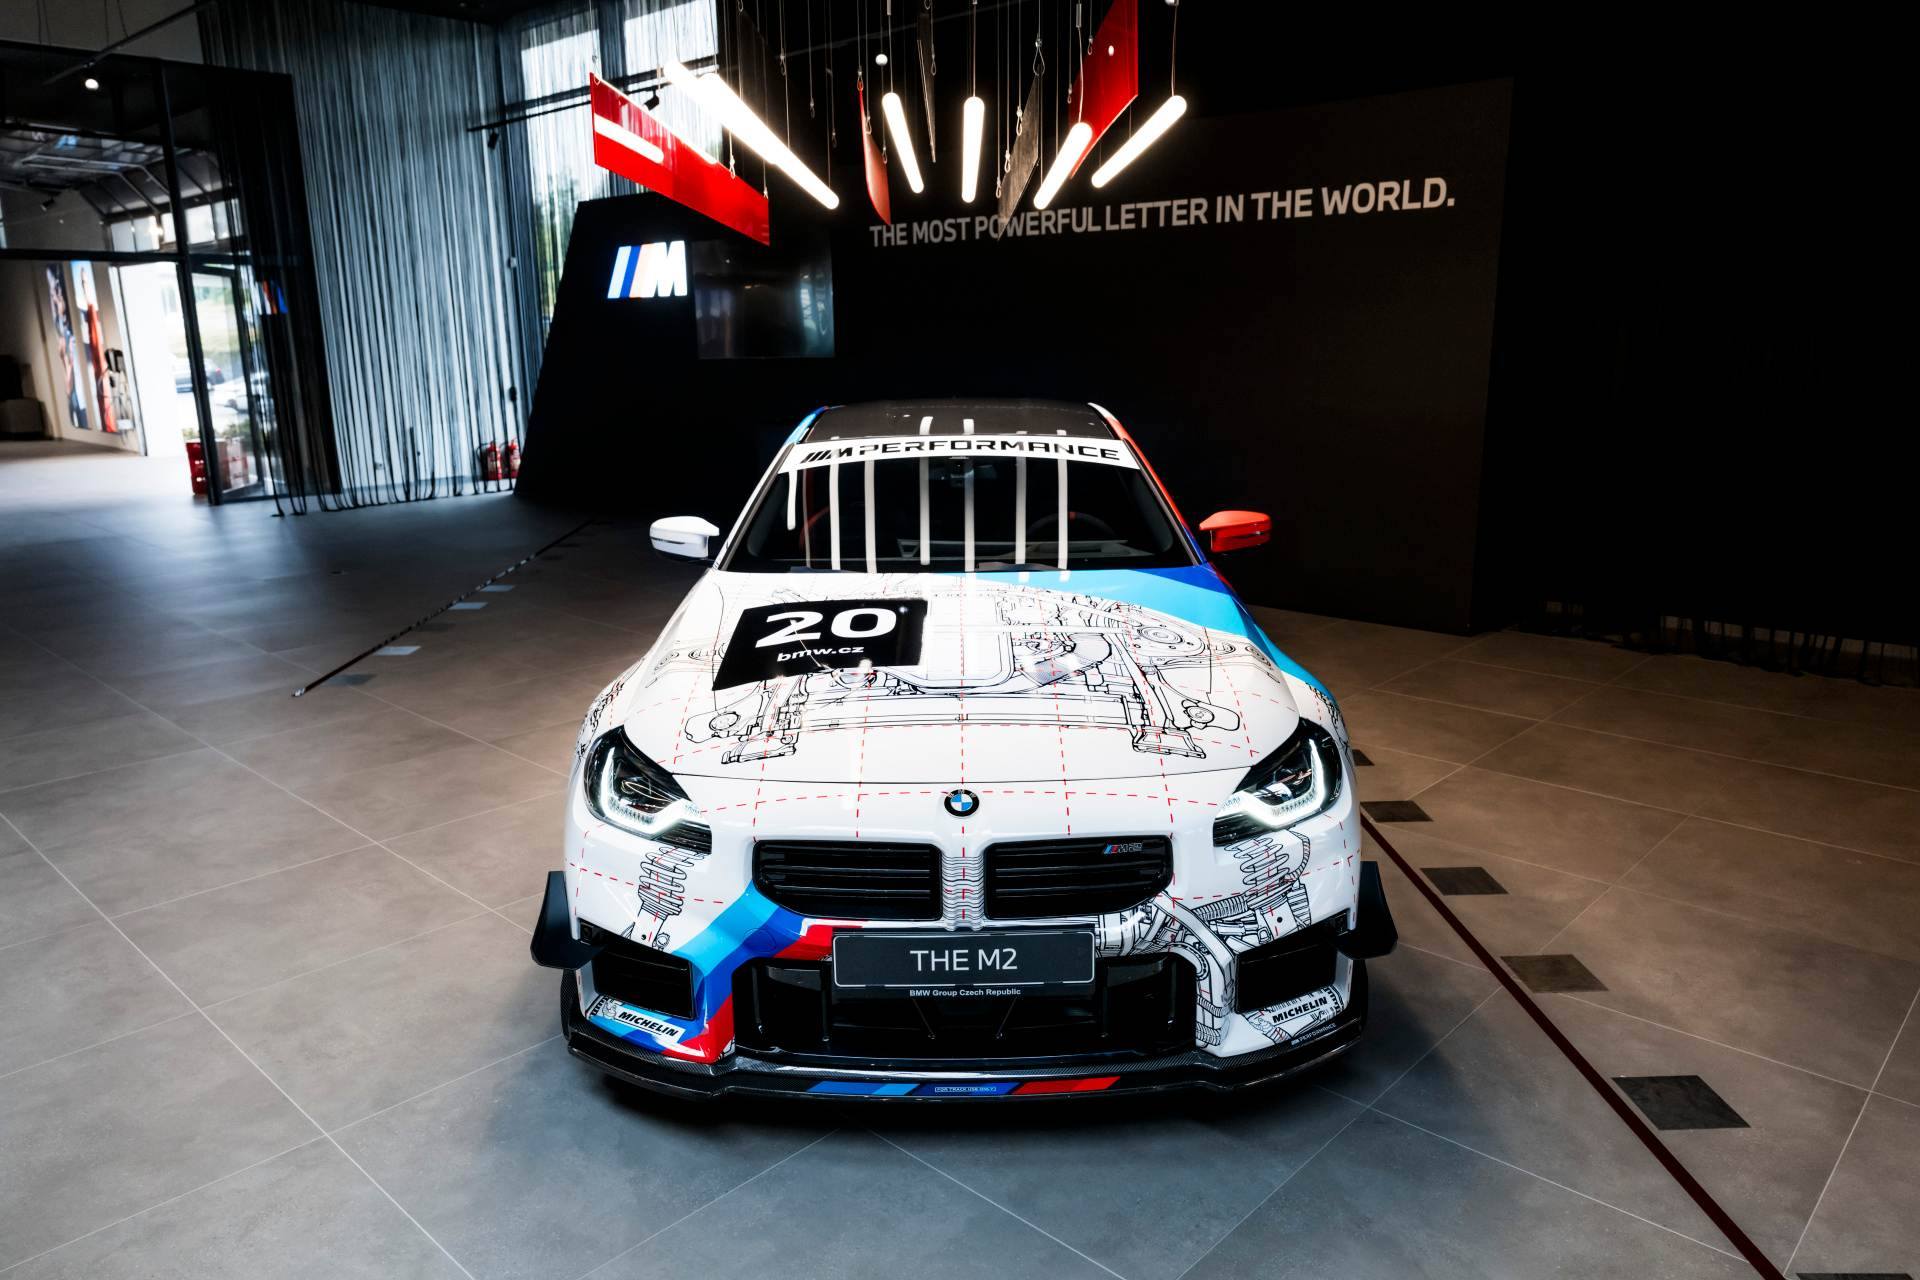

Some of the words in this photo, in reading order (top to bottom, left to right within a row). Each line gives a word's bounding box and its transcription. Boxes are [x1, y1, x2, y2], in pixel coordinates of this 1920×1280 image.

[869, 223, 908, 248] THE
[912, 216, 971, 245] MOST
[1105, 197, 1209, 231] LETTER
[1215, 194, 1245, 224] IN
[1250, 187, 1313, 221] THE
[1321, 176, 1456, 216] WORLD.
[859, 439, 1121, 461] PERFORMANCE
[754, 607, 898, 649] 20
[776, 646, 865, 663] bmw.cz
[909, 949, 970, 972] THE
[978, 947, 1018, 971] M2
[909, 989, 931, 997] BMW
[932, 989, 958, 997] Group
[959, 988, 984, 996] Czech
[985, 988, 1021, 996] Republic
[1272, 996, 1328, 1024] MICHELIN
[618, 1011, 680, 1037] MICHELIN
